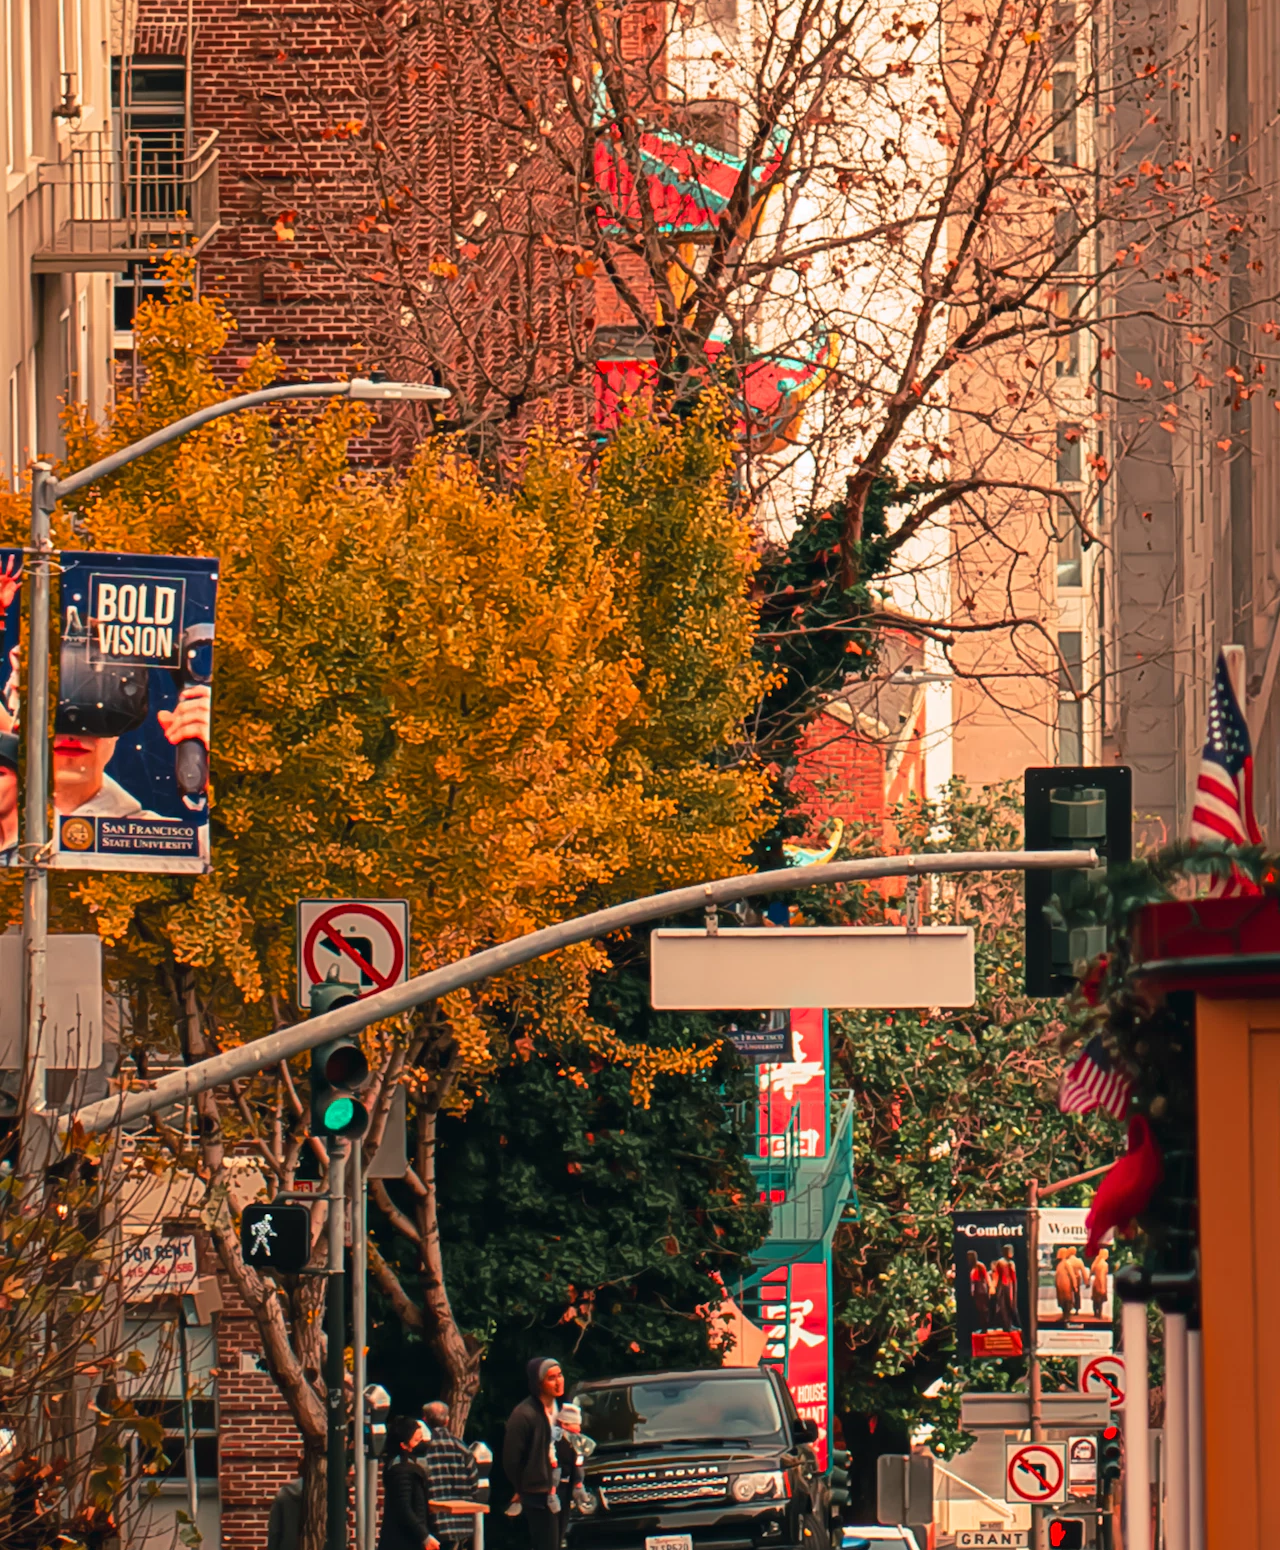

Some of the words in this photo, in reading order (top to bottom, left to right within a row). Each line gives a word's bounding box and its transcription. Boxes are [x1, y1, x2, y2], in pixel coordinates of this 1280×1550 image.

[98, 583, 176, 625] BOLD
[99, 624, 173, 658] VISION
[102, 822, 127, 835] SAN
[129, 824, 194, 837] FRANCISCO
[102, 837, 131, 848] STATE
[133, 838, 193, 851] UNIVERSITY
[156, 1242, 190, 1260] RENT
[797, 1383, 827, 1404] HOUSE
[664, 1465, 719, 1478] ROVER
[961, 1532, 1023, 1545] GRANT
